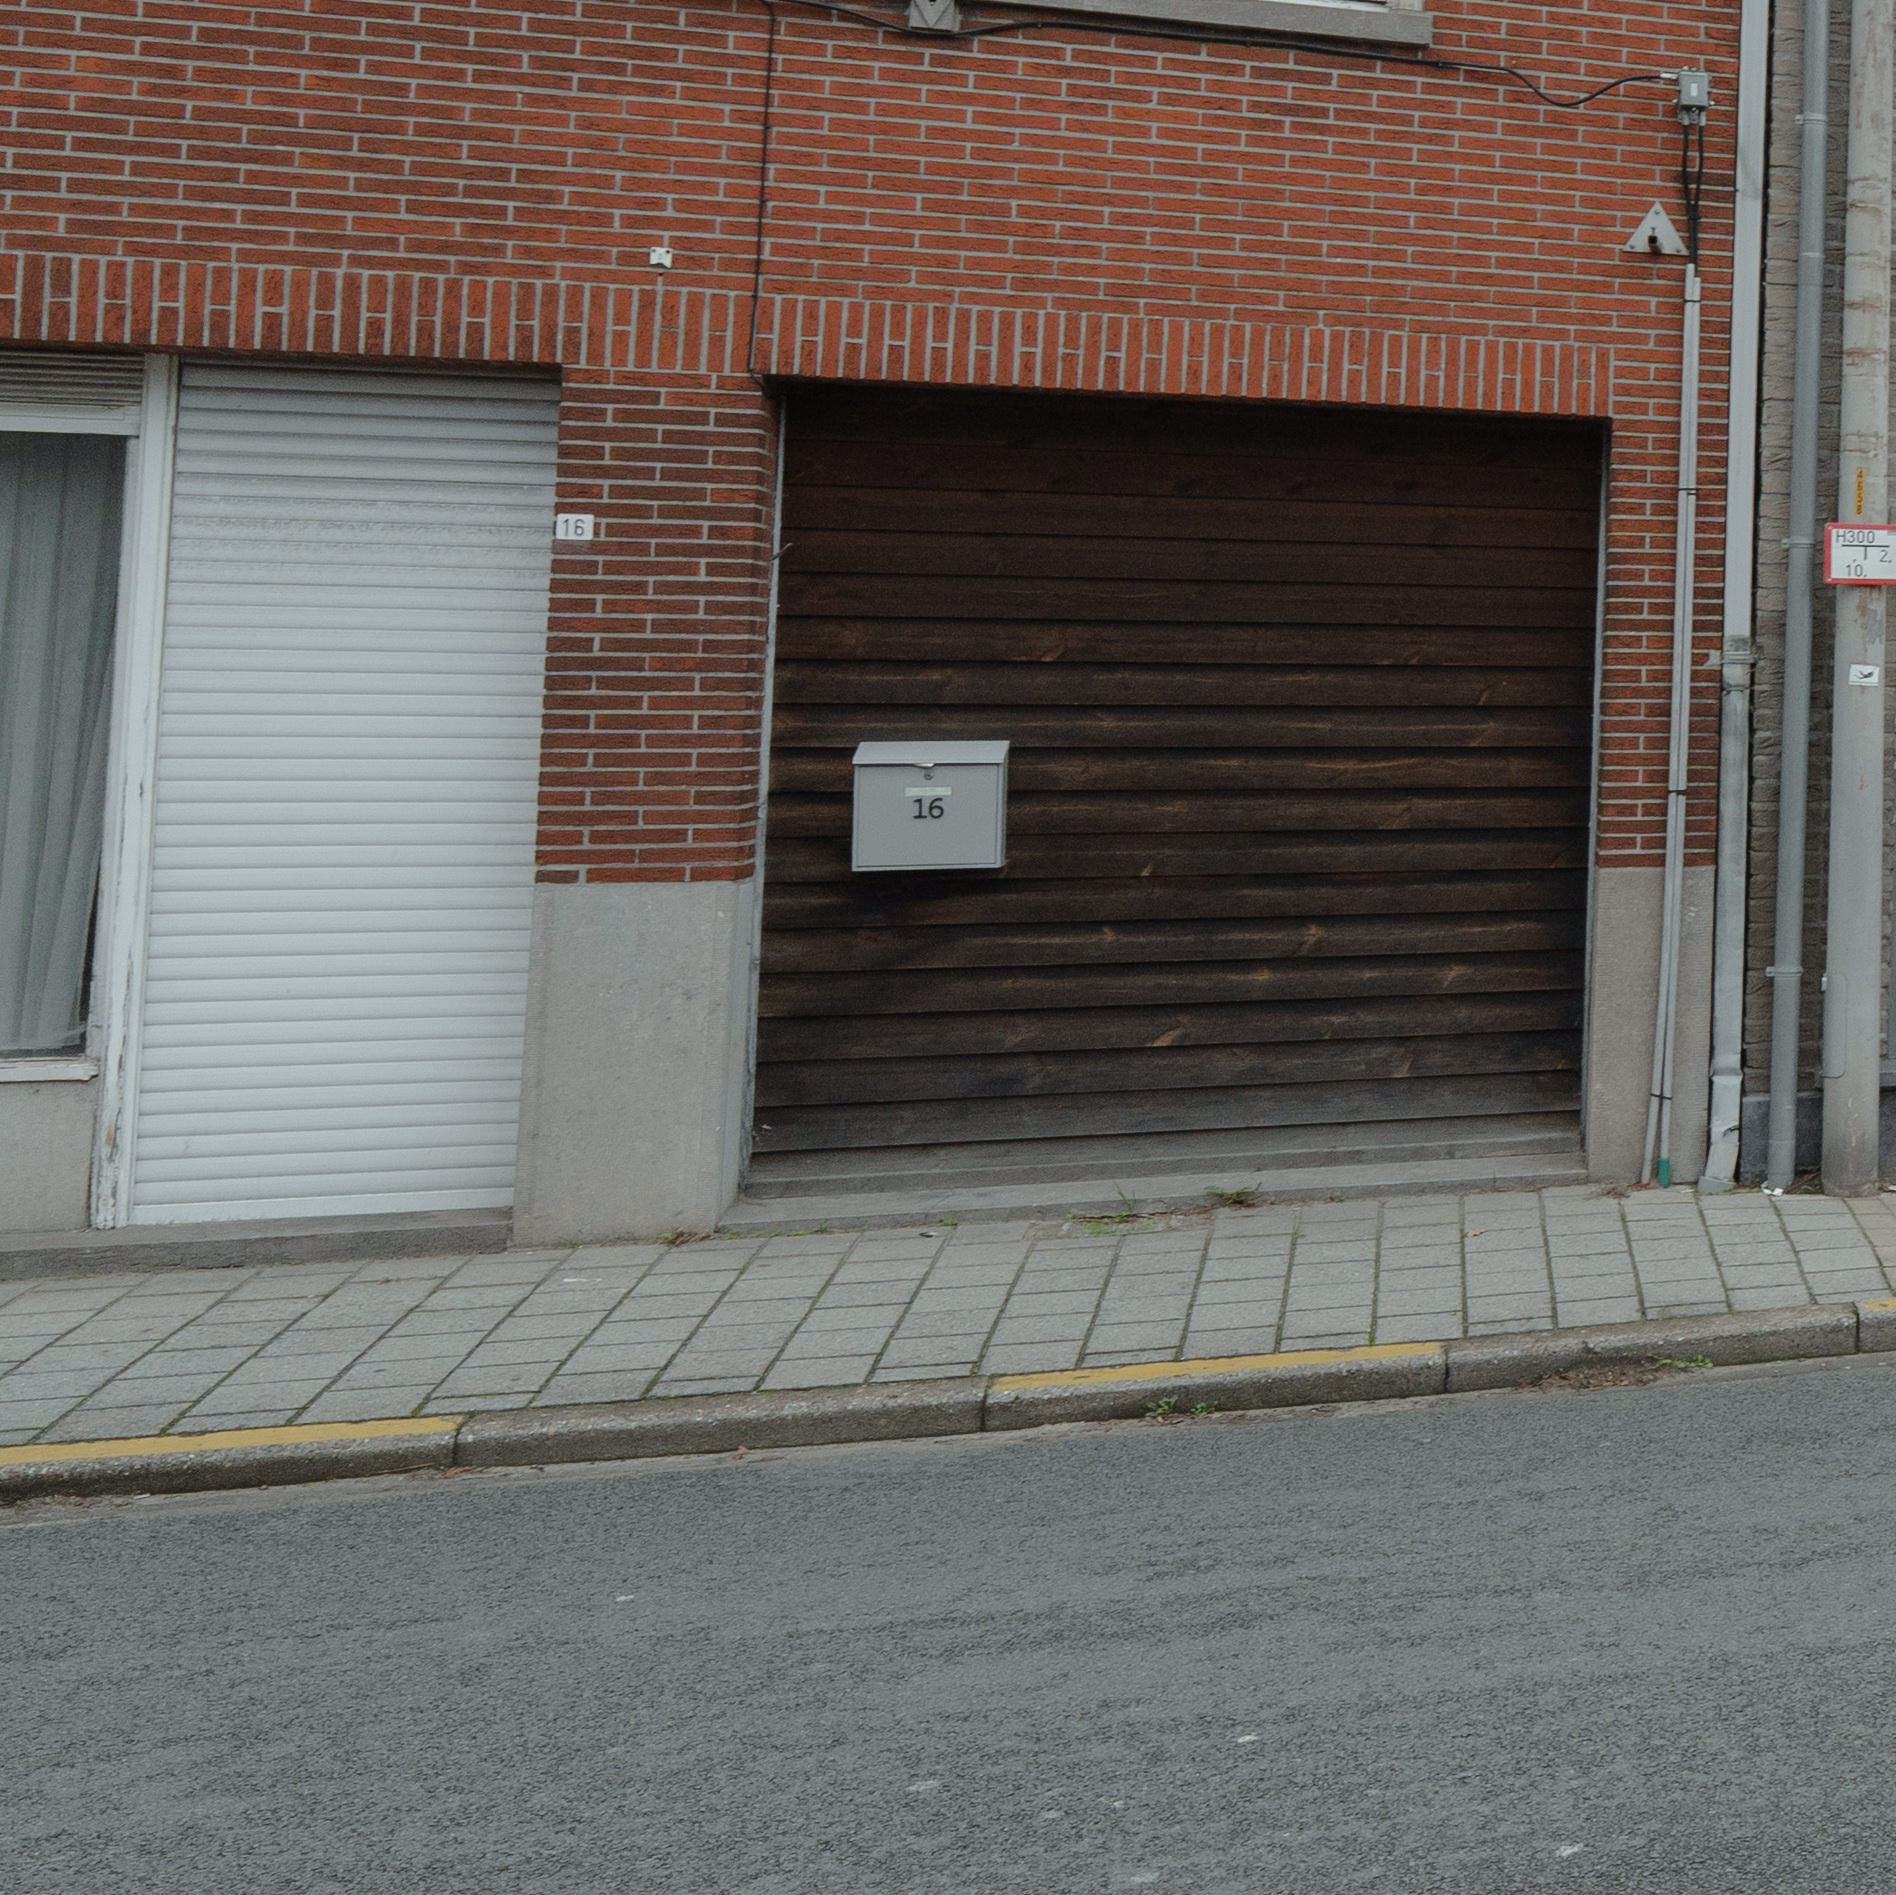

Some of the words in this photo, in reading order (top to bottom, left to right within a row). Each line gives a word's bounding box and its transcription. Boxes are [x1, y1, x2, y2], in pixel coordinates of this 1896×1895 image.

[562, 518, 585, 537] 16
[1835, 530, 1875, 544] H300
[912, 797, 945, 819] 16
